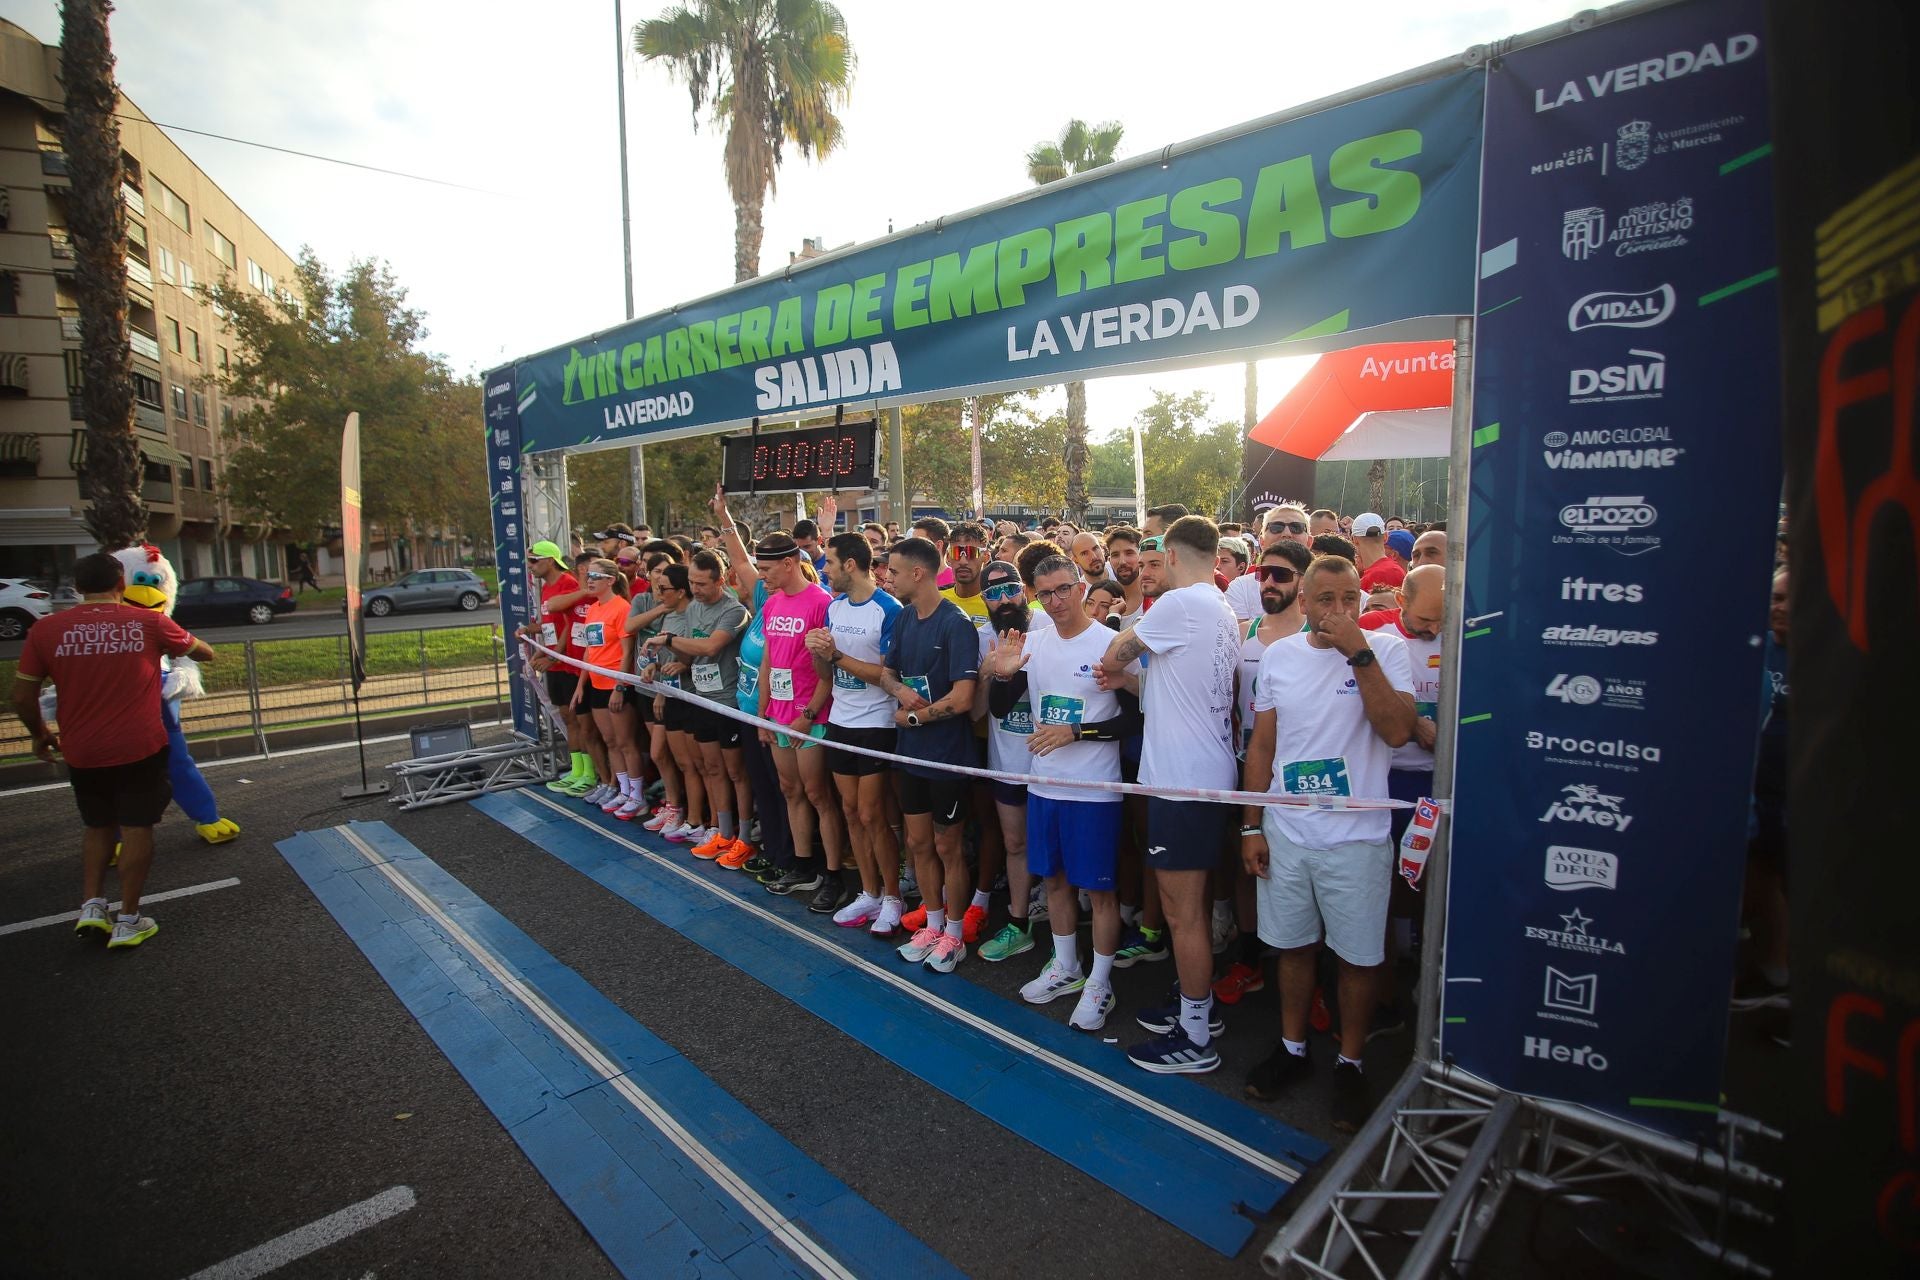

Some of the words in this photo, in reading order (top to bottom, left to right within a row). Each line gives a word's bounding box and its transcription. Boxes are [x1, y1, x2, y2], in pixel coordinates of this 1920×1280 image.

[1535, 82, 1584, 113] LA
[1587, 34, 1759, 99] VERDAD
[1654, 114, 1745, 143] Ayuntamiento
[1653, 142, 1670, 155] de
[1672, 132, 1722, 152] Murcia
[1531, 153, 1594, 175] MURCIA
[1618, 203, 1693, 229] murcia
[1608, 217, 1693, 242] ATLETISMO
[578, 348, 618, 401] VII
[621, 296, 804, 391] CARRERA
[814, 272, 886, 348] DE
[893, 129, 1423, 331] EMPRESAS
[1584, 297, 1659, 321] VIDAL
[1007, 320, 1053, 362] LA
[1063, 284, 1260, 354] VERDAD
[754, 341, 902, 411] SALIDA
[1359, 351, 1455, 382] Ayunta
[1569, 361, 1665, 396] DSM
[604, 405, 627, 430] LA
[624, 391, 694, 426] VERDAD
[1551, 535, 1574, 545] Uno
[1597, 535, 1609, 544] de
[1561, 576, 1644, 603] itres
[63, 625, 144, 644] murcia
[74, 621, 116, 632] región
[126, 620, 144, 629] de
[1541, 624, 1659, 646] atalayas
[54, 641, 145, 657] ATLETISMO
[1606, 683, 1644, 698] AÑOS
[1046, 706, 1071, 721] 537
[1525, 731, 1661, 762] Brocalsa
[1298, 773, 1333, 790] 534
[1538, 801, 1633, 832] jokey
[1553, 851, 1611, 868] AQUA
[1555, 863, 1608, 880] DEUS
[1524, 926, 1626, 955] ESTRELLA
[1523, 1035, 1609, 1072] Hero
